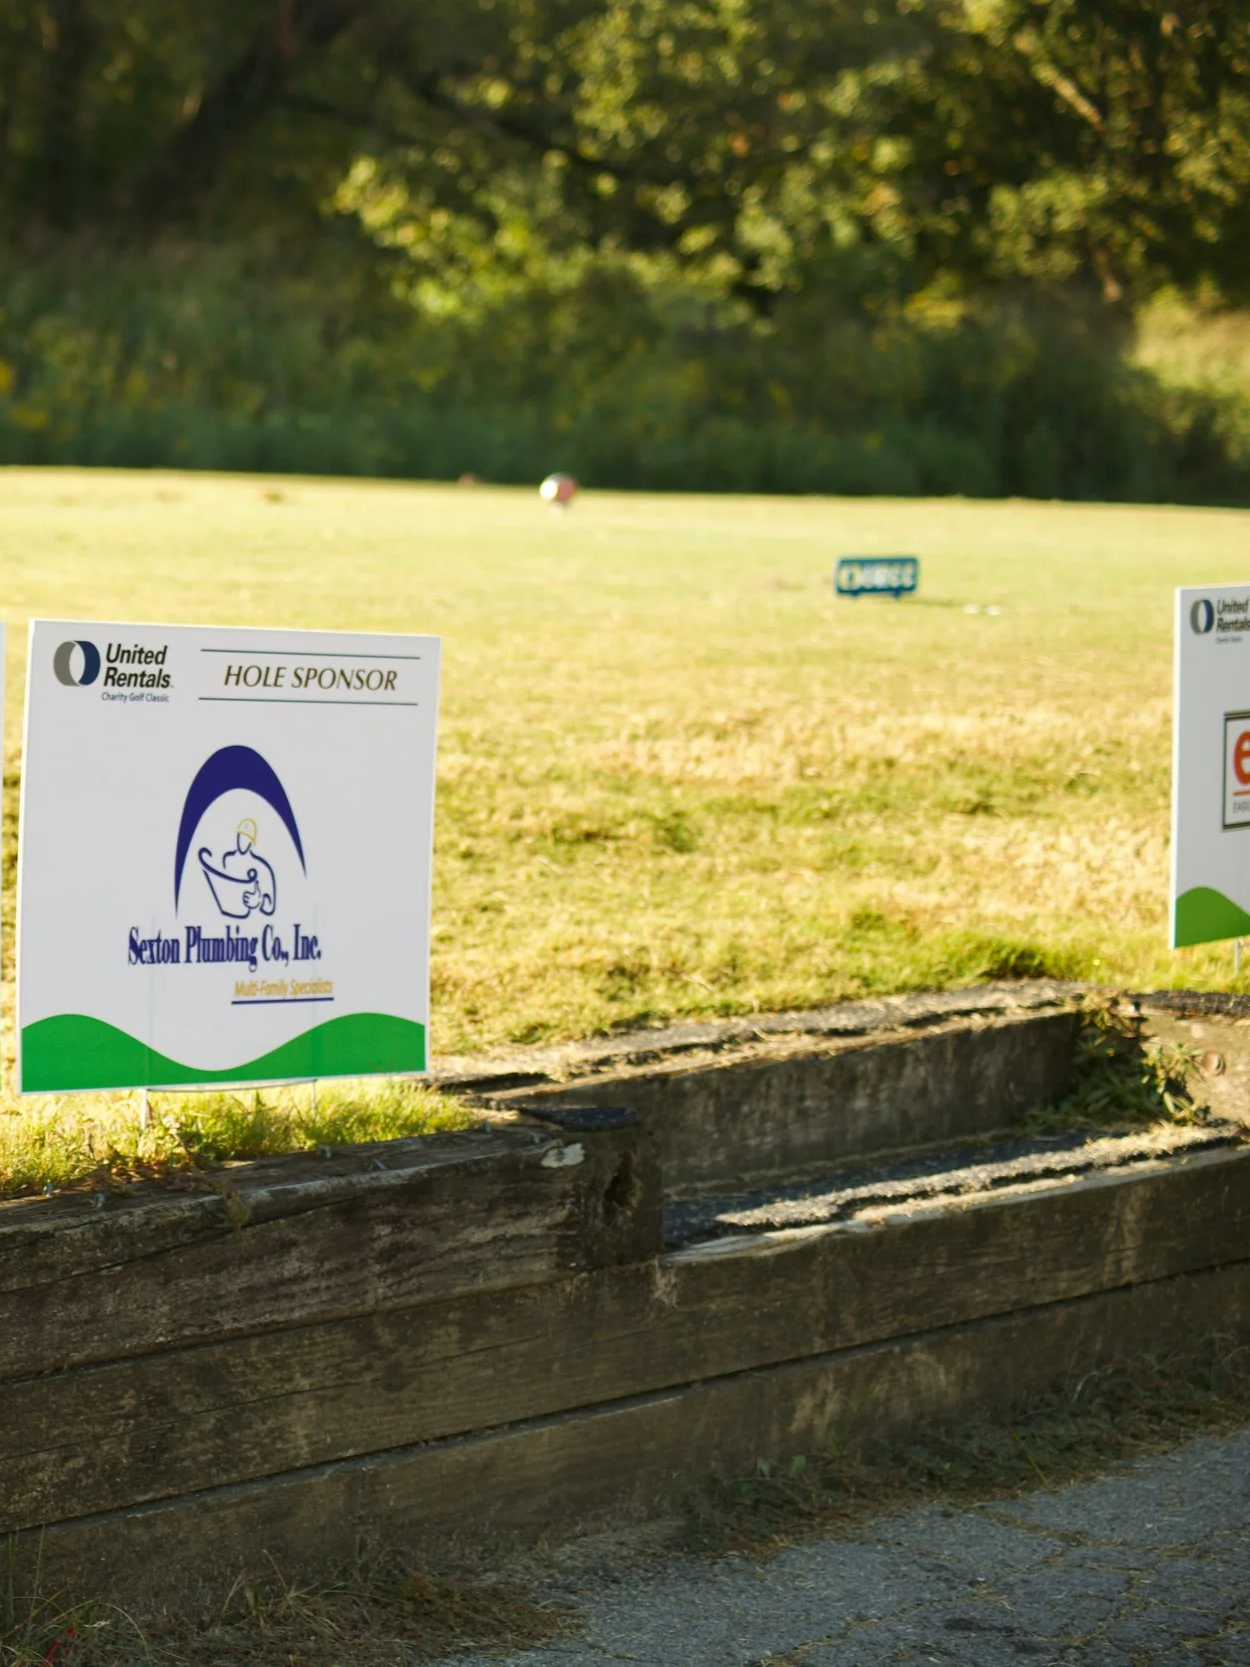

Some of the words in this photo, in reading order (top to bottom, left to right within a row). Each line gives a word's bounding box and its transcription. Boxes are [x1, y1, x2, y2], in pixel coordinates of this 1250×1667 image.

[106, 643, 168, 665] United
[103, 667, 171, 688] Rentals
[224, 665, 286, 687] HOLE
[291, 667, 398, 691] SPONSOR
[101, 691, 128, 703] Charity
[129, 692, 144, 702] Golf
[145, 692, 169, 703] Classic
[128, 926, 180, 965] Sexton
[184, 925, 258, 972] Plumbing
[293, 924, 322, 960] Inc.
